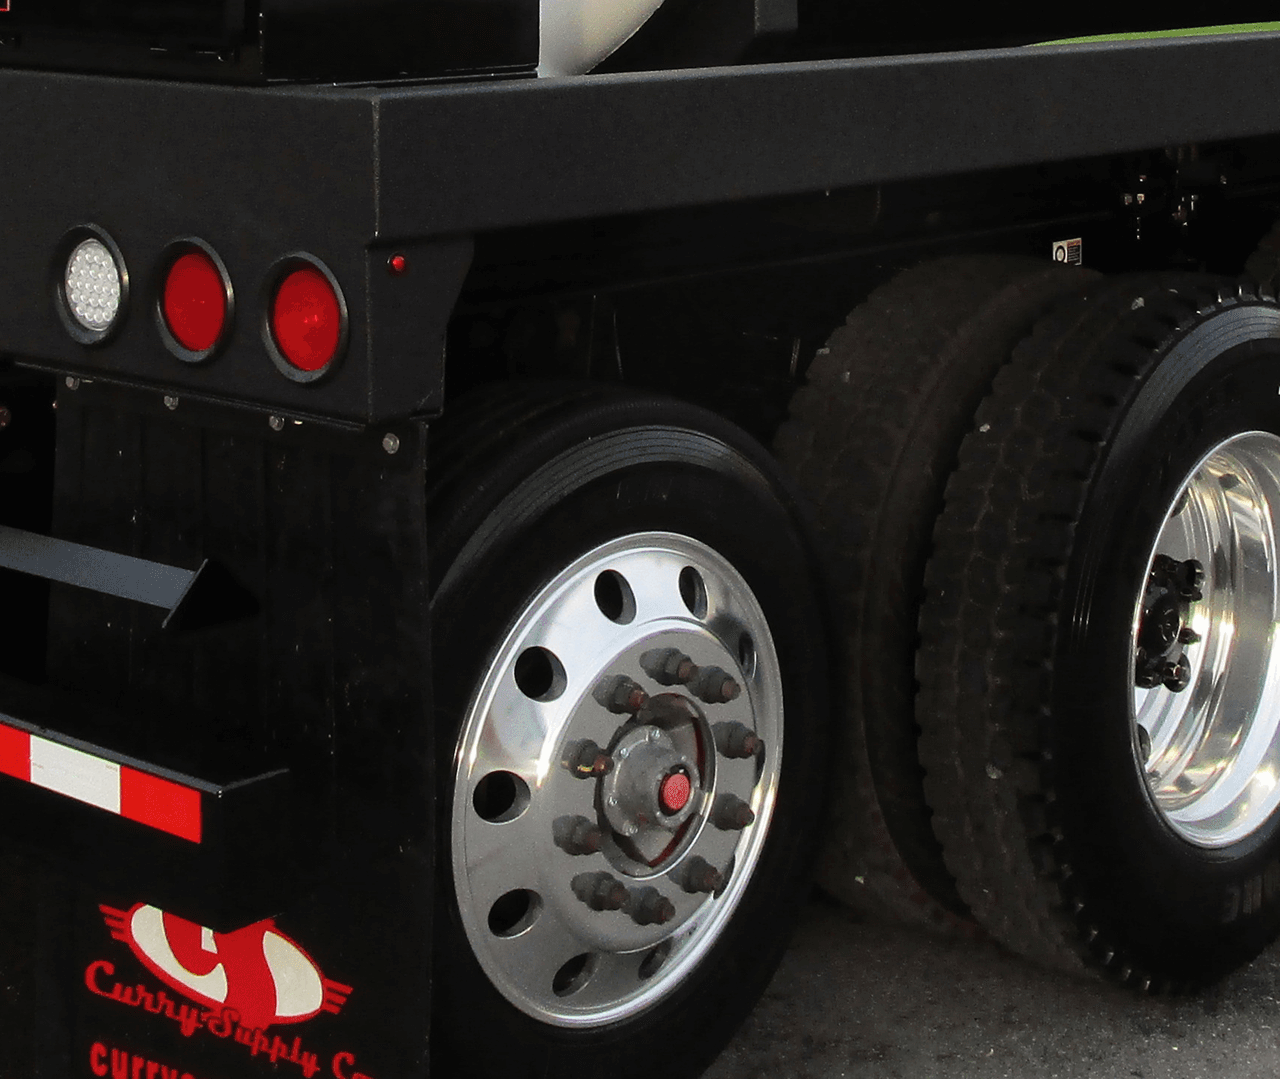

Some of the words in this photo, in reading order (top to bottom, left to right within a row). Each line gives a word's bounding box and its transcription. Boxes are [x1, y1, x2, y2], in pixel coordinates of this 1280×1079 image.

[84, 960, 204, 1037] Curry
[203, 1006, 322, 1079] Supply
[332, 1051, 373, 1079] C
